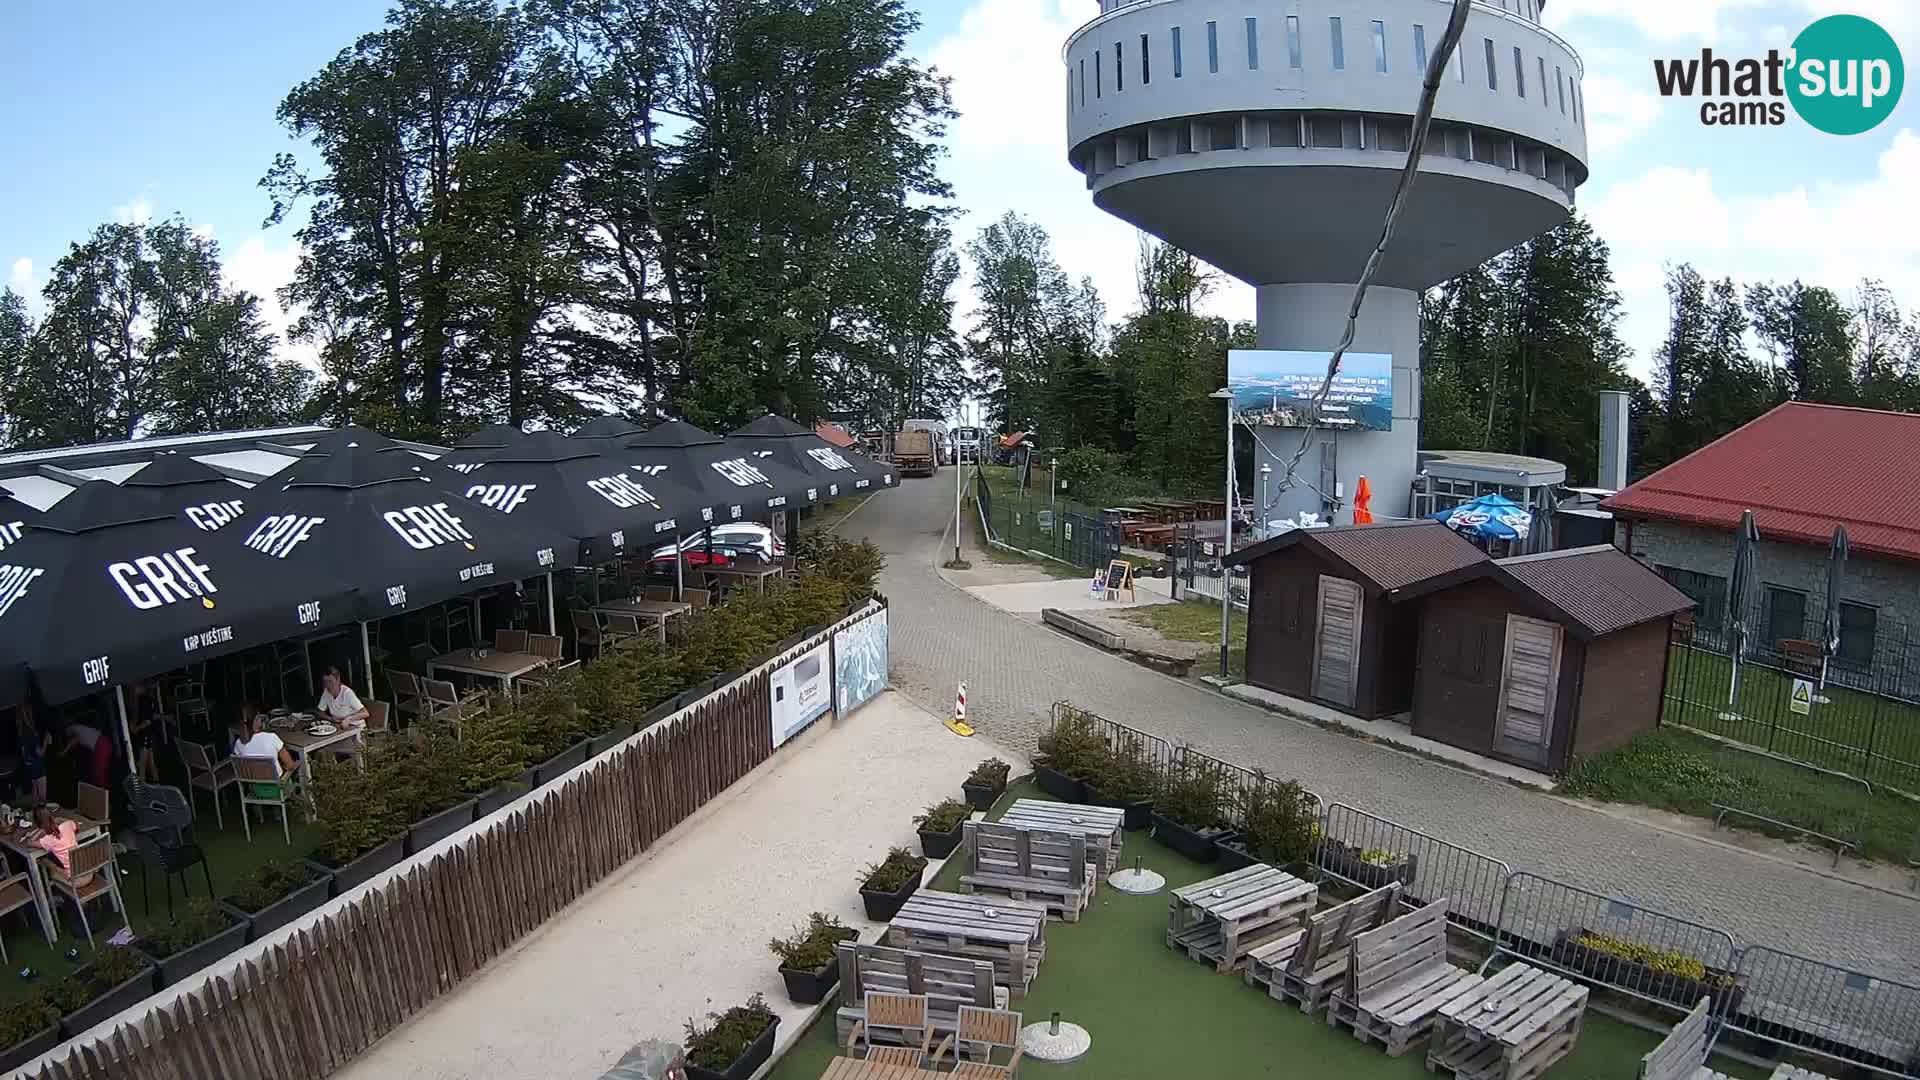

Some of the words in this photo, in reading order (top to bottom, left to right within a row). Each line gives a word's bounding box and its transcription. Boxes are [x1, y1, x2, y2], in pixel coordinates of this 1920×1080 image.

[586, 473, 656, 508] GRIF
[244, 514, 326, 558] GRIF
[383, 502, 473, 550] GRIF
[108, 547, 218, 610] GRIF
[386, 584, 407, 607] GRIF
[298, 601, 321, 625] GRIF
[83, 656, 110, 685] GRIF
